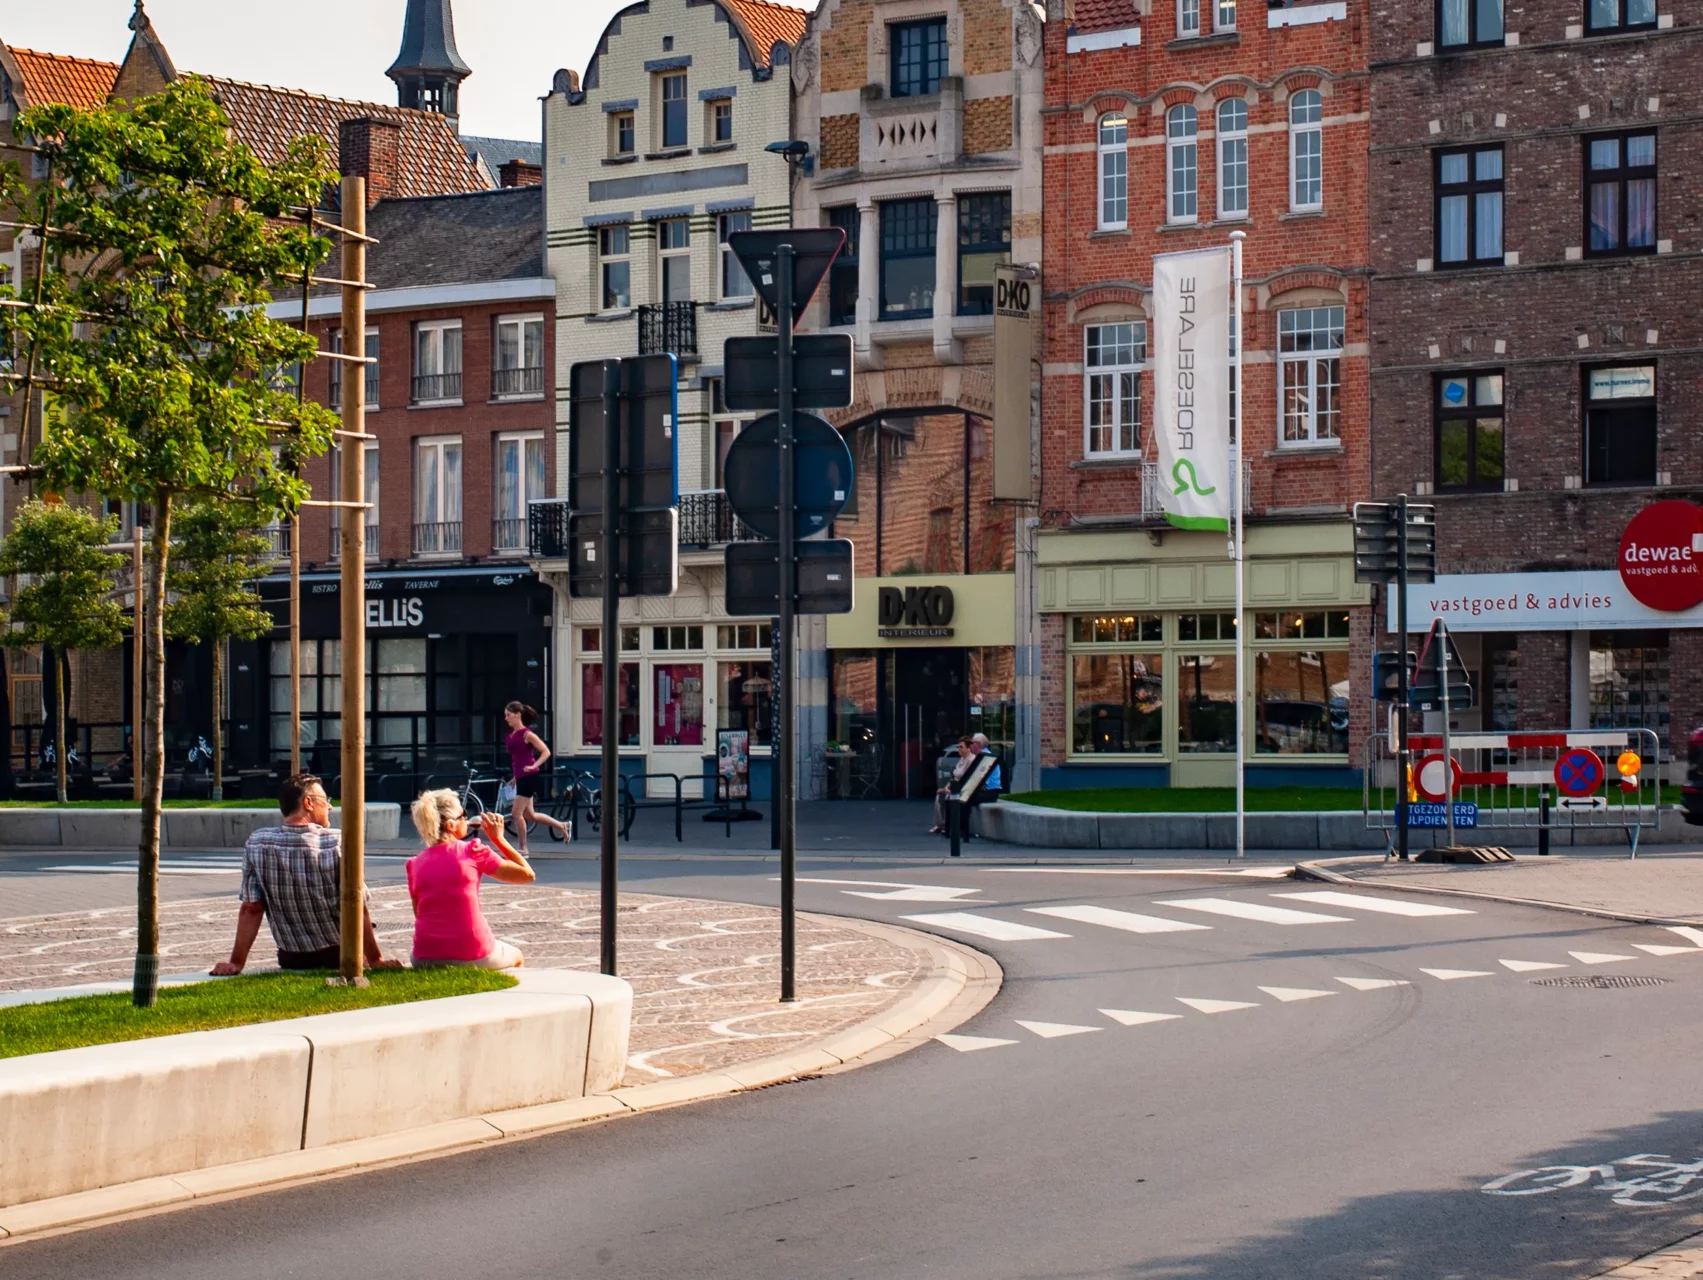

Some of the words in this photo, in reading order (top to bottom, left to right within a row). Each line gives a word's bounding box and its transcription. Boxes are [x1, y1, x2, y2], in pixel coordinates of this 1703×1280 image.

[1624, 542, 1692, 562] dewae
[1626, 564, 1669, 577] vastgoed
[1671, 564, 1678, 574] &
[1680, 562, 1699, 574] adv
[312, 584, 337, 593] BISTRO
[364, 580, 383, 589] ellis
[404, 580, 439, 590] TAVERNE
[1430, 594, 1518, 616] vastgoed
[1526, 593, 1540, 610] &
[1548, 593, 1612, 609] advies
[365, 597, 424, 627] ELLiS
[879, 629, 949, 637] INTERIEUR
[1408, 804, 1475, 815] TGEZONERD
[1408, 815, 1474, 825] ULPDIENTEN
